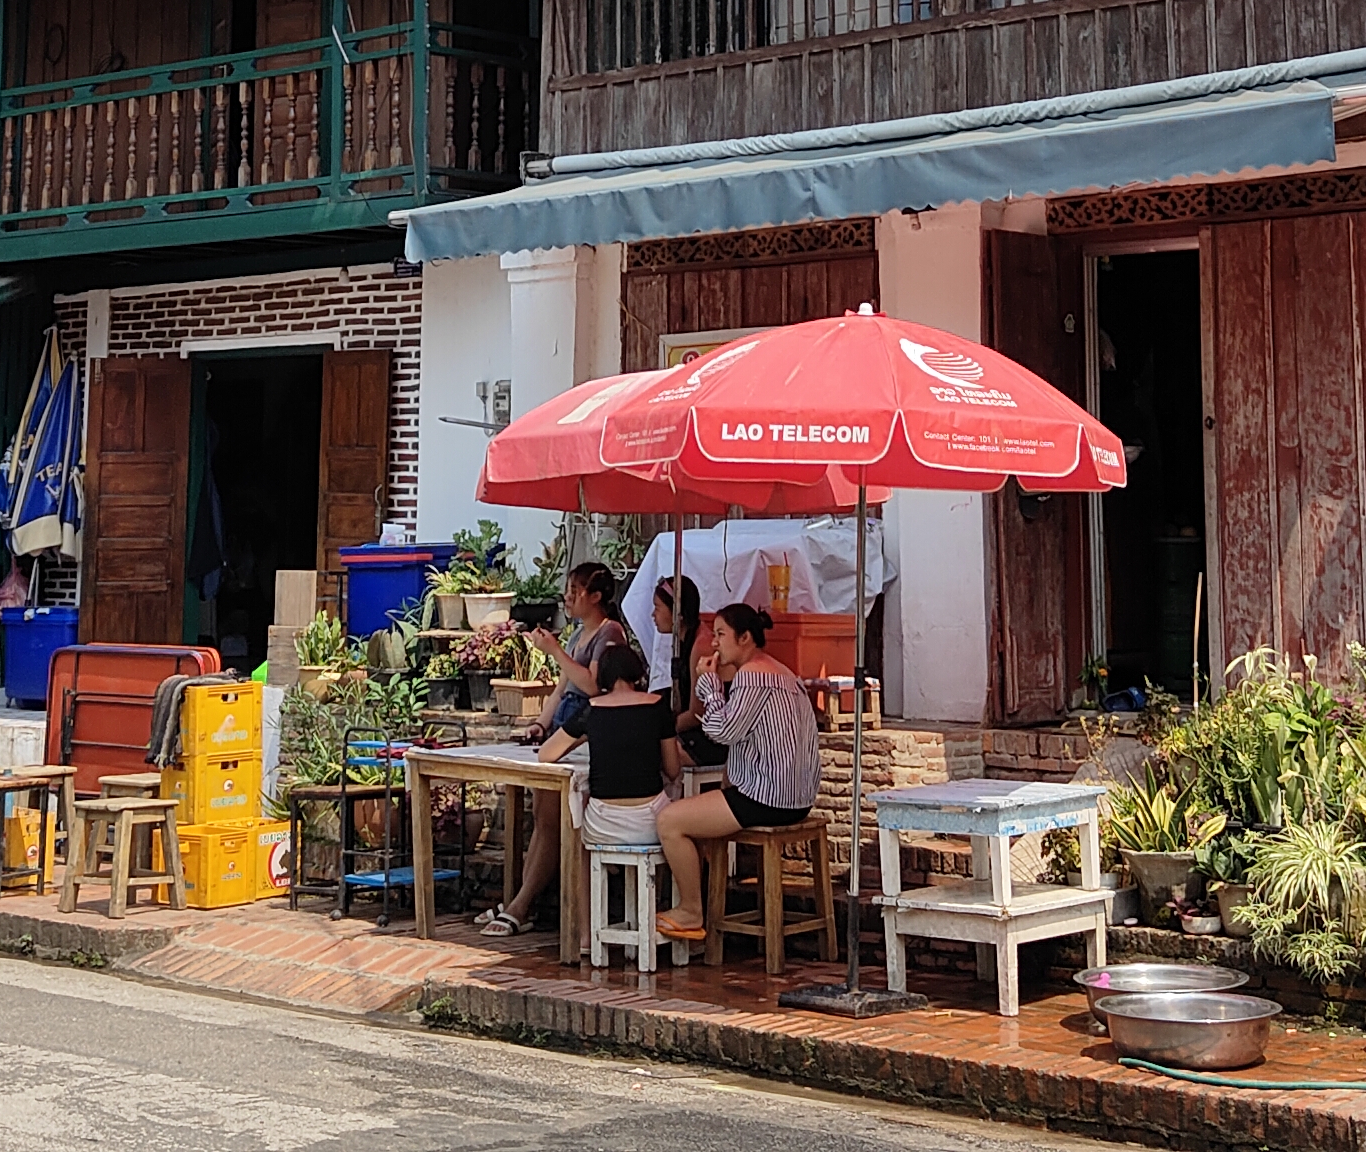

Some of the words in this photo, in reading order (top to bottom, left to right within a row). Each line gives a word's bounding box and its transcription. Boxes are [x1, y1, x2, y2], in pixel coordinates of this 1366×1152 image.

[936, 394, 961, 403] LAO
[961, 396, 1018, 408] TELECOM
[721, 423, 763, 441] LAO
[768, 424, 870, 443] TELECOM
[923, 431, 950, 441] Contact
[978, 435, 991, 443] 101
